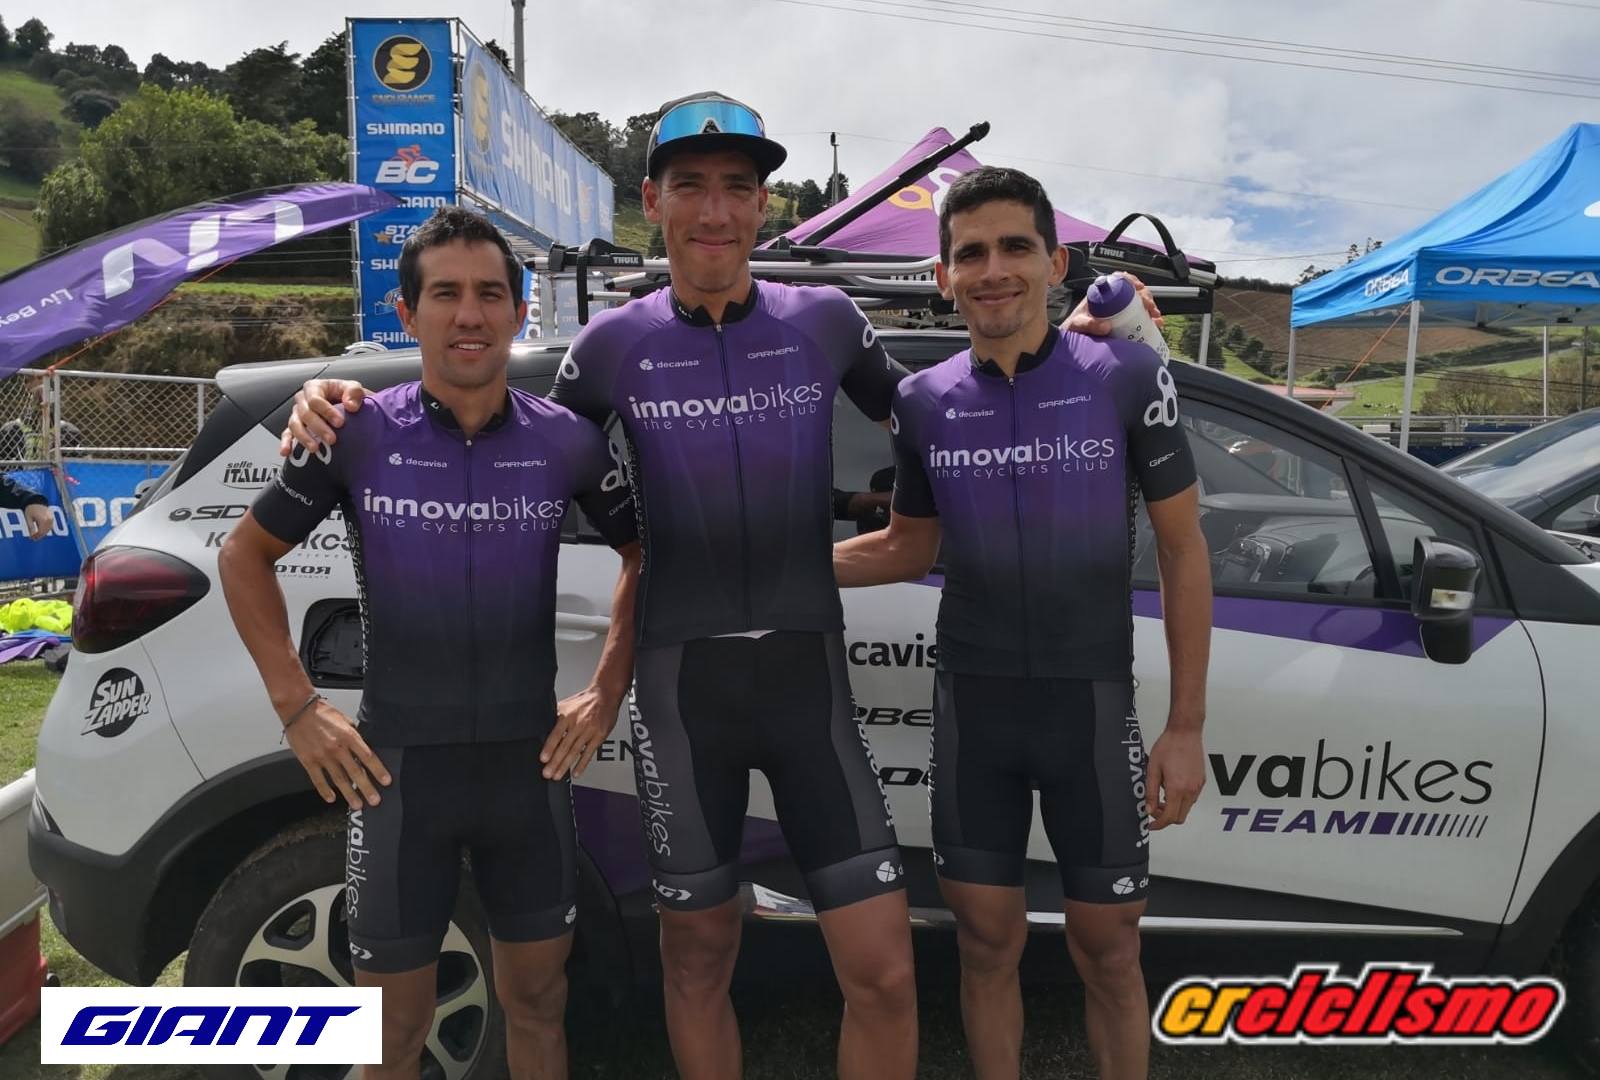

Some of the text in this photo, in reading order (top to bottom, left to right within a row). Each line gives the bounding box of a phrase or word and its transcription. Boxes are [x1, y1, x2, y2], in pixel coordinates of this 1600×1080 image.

[366, 123, 446, 135] SHIMANO
[375, 160, 440, 184] BC
[612, 255, 639, 266] THULE
[1435, 266, 1600, 288] ORBEA
[747, 345, 799, 361] GARNEAU
[656, 359, 700, 370] decavisa
[628, 382, 823, 419] innovabikes
[1038, 394, 1092, 410] GARNEAU
[643, 403, 817, 431] the cyclers club
[958, 408, 995, 419] decavisa
[929, 434, 1115, 469] innovabikes
[405, 457, 448, 469] decavisa
[493, 459, 547, 469] GARNEAU
[936, 459, 1109, 480] the cyclers club
[364, 488, 565, 520] innovabikes
[372, 514, 559, 535] the cyclers club
[95, 676, 138, 708] SUN
[81, 692, 152, 736] ZAPPER
[1220, 807, 1370, 835] TEAM
